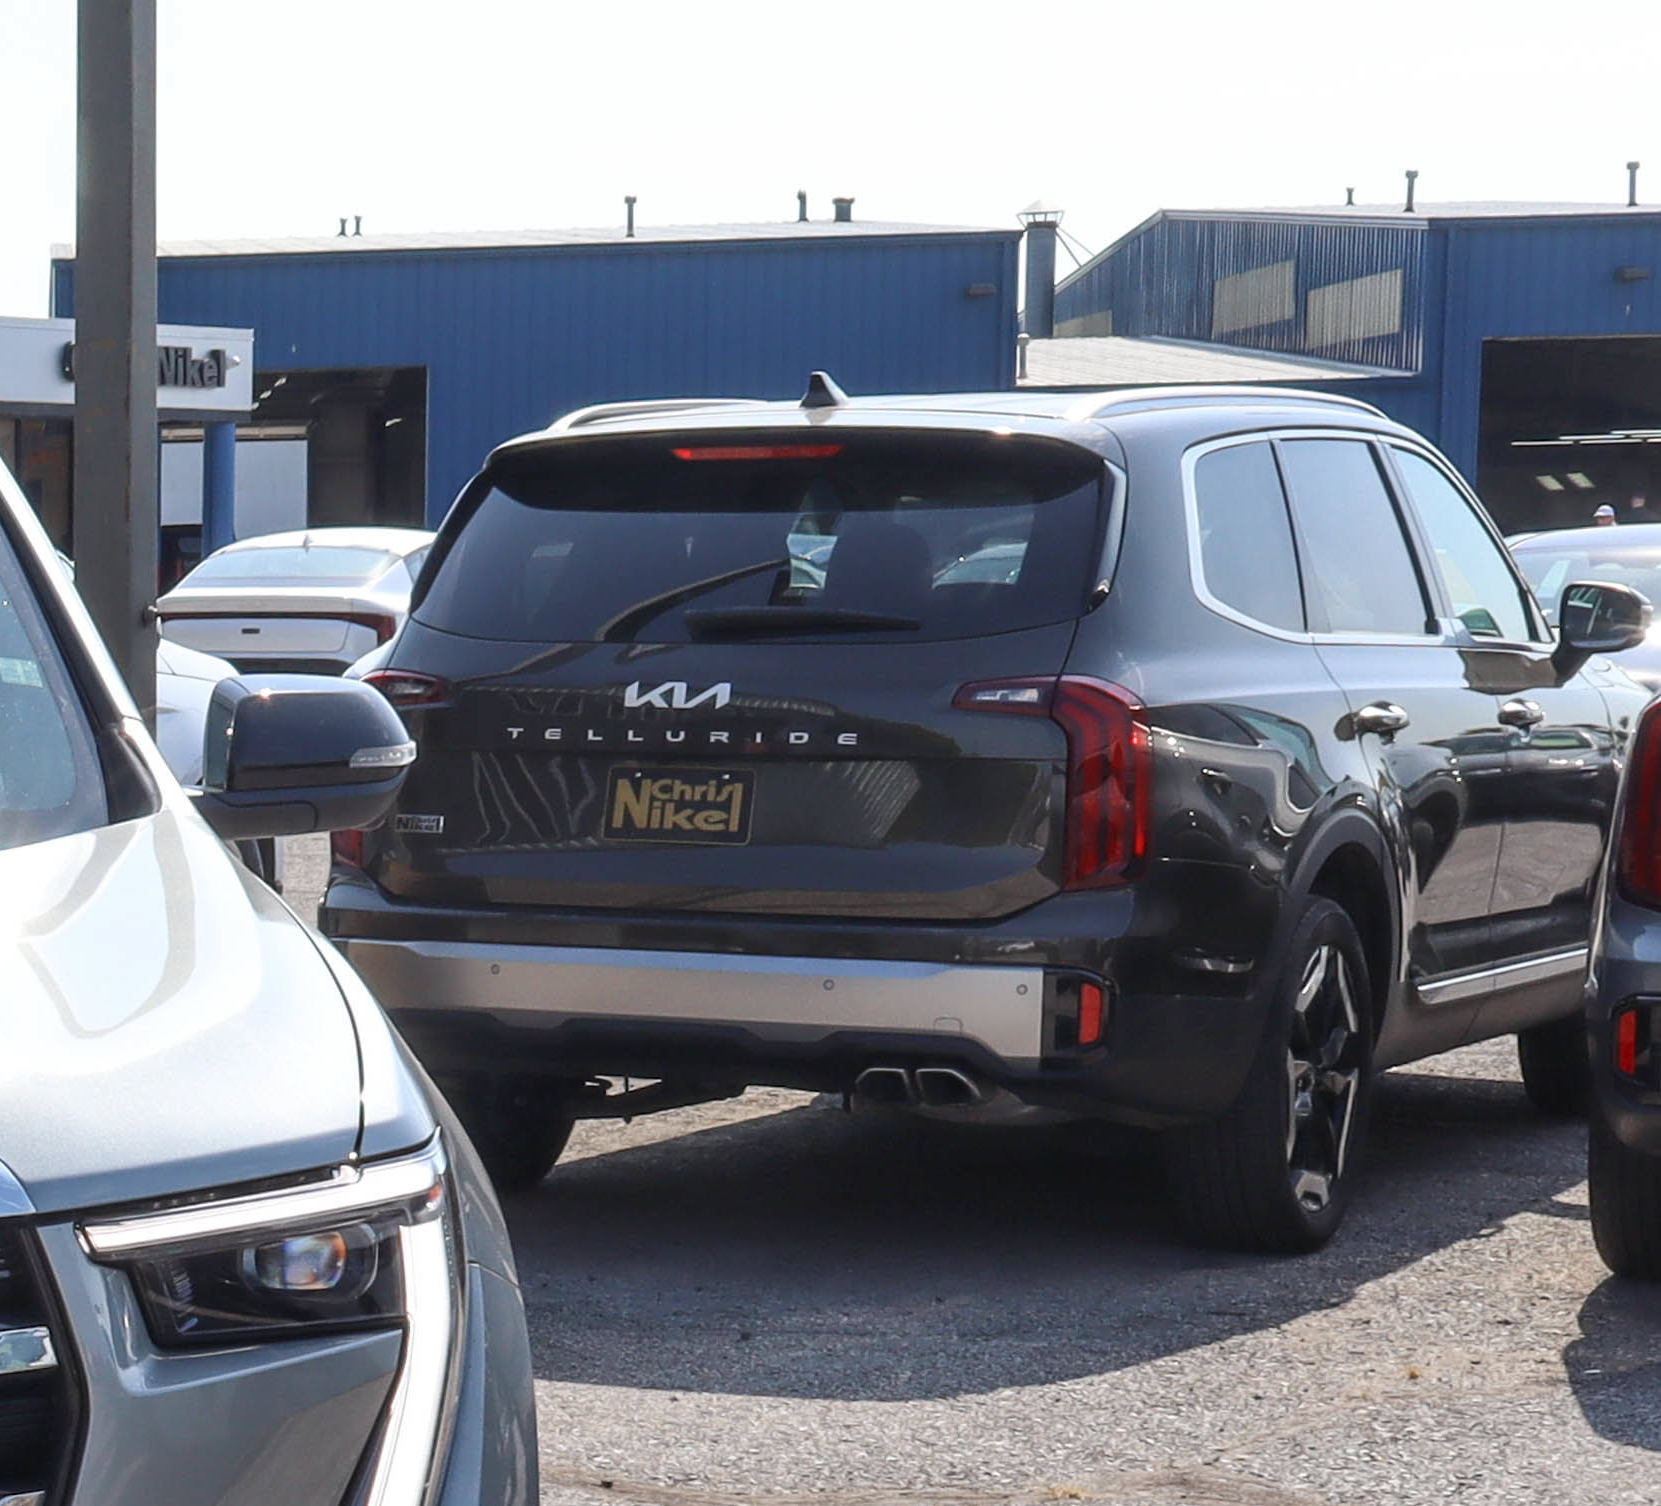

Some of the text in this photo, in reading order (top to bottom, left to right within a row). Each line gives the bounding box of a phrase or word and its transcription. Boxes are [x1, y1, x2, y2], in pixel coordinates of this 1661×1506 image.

[156, 346, 226, 387] Nikel
[624, 681, 731, 709] KIA
[507, 727, 858, 746] TELLURIDE
[651, 779, 736, 802] Chris
[612, 779, 743, 832] Nikel
